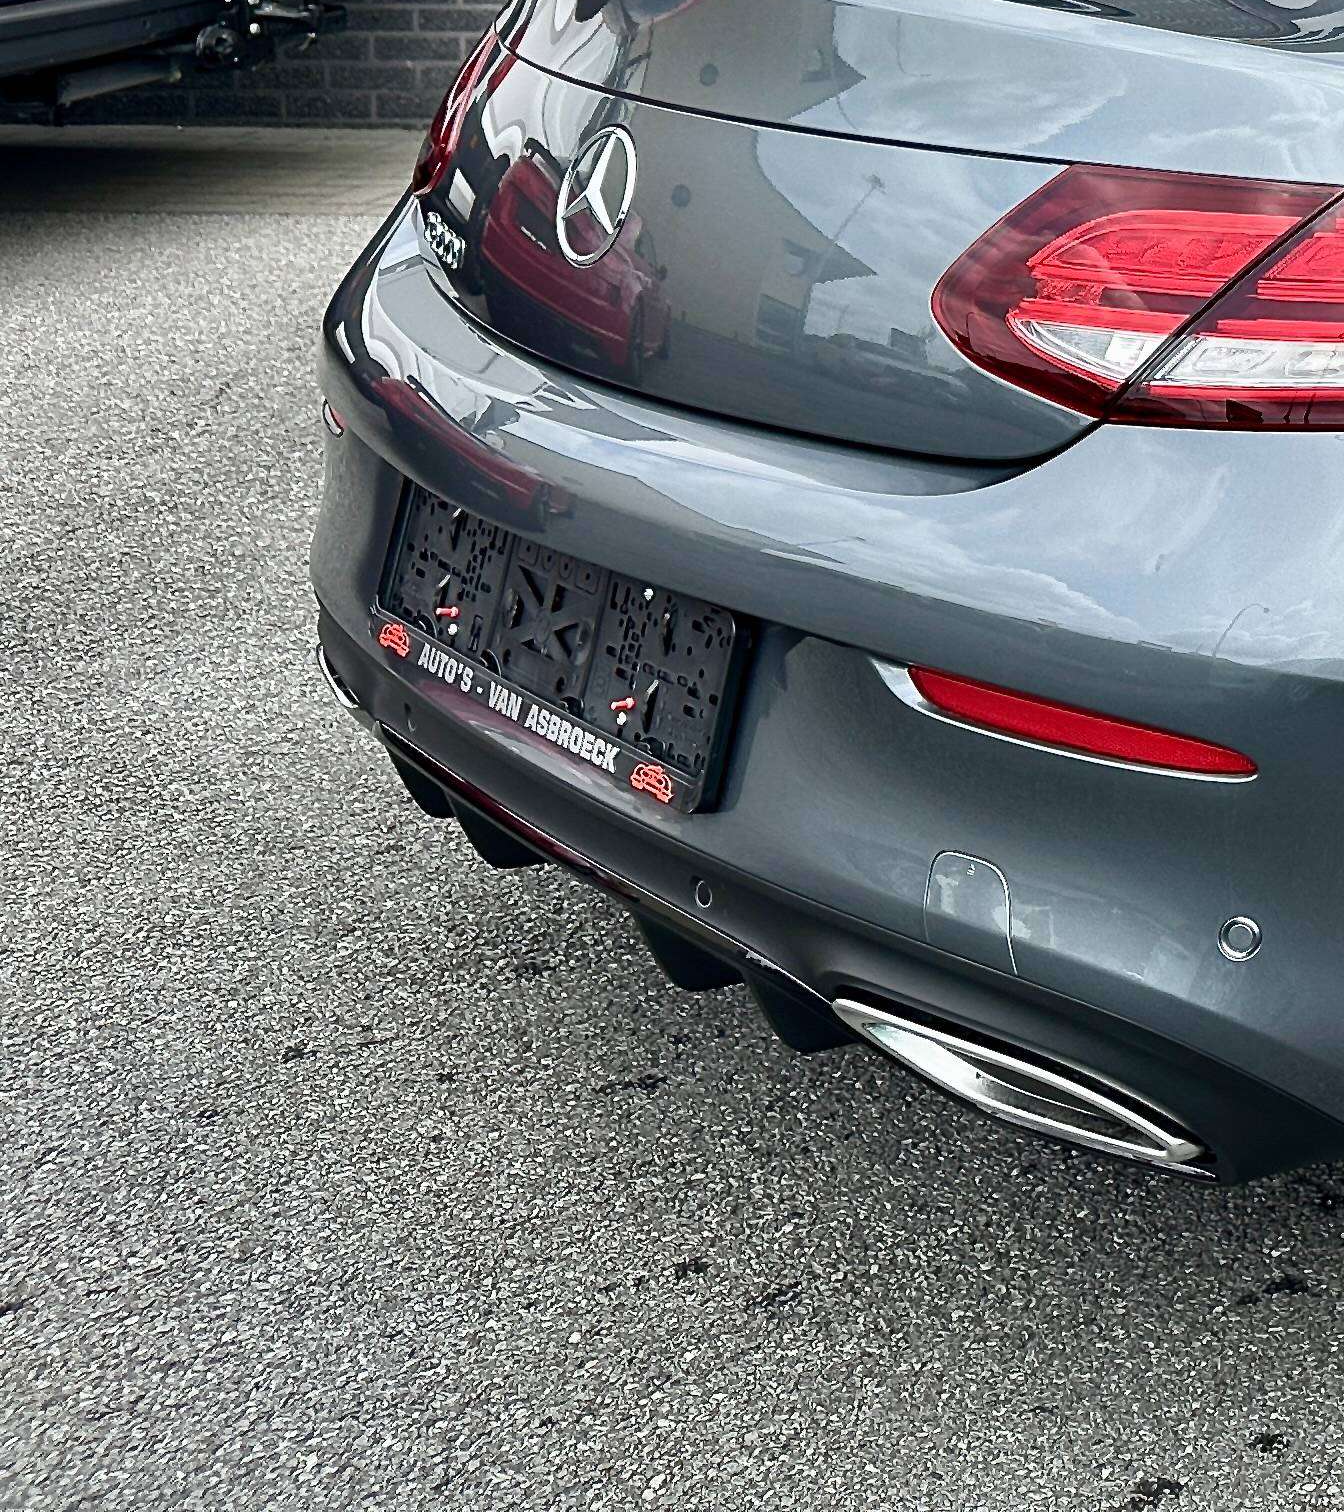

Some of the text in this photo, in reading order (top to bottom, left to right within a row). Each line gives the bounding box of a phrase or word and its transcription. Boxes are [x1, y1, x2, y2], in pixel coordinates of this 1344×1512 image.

[417, 642, 474, 693] AUTO'S
[488, 681, 522, 721] VAN
[524, 704, 621, 774] ASBROECK
